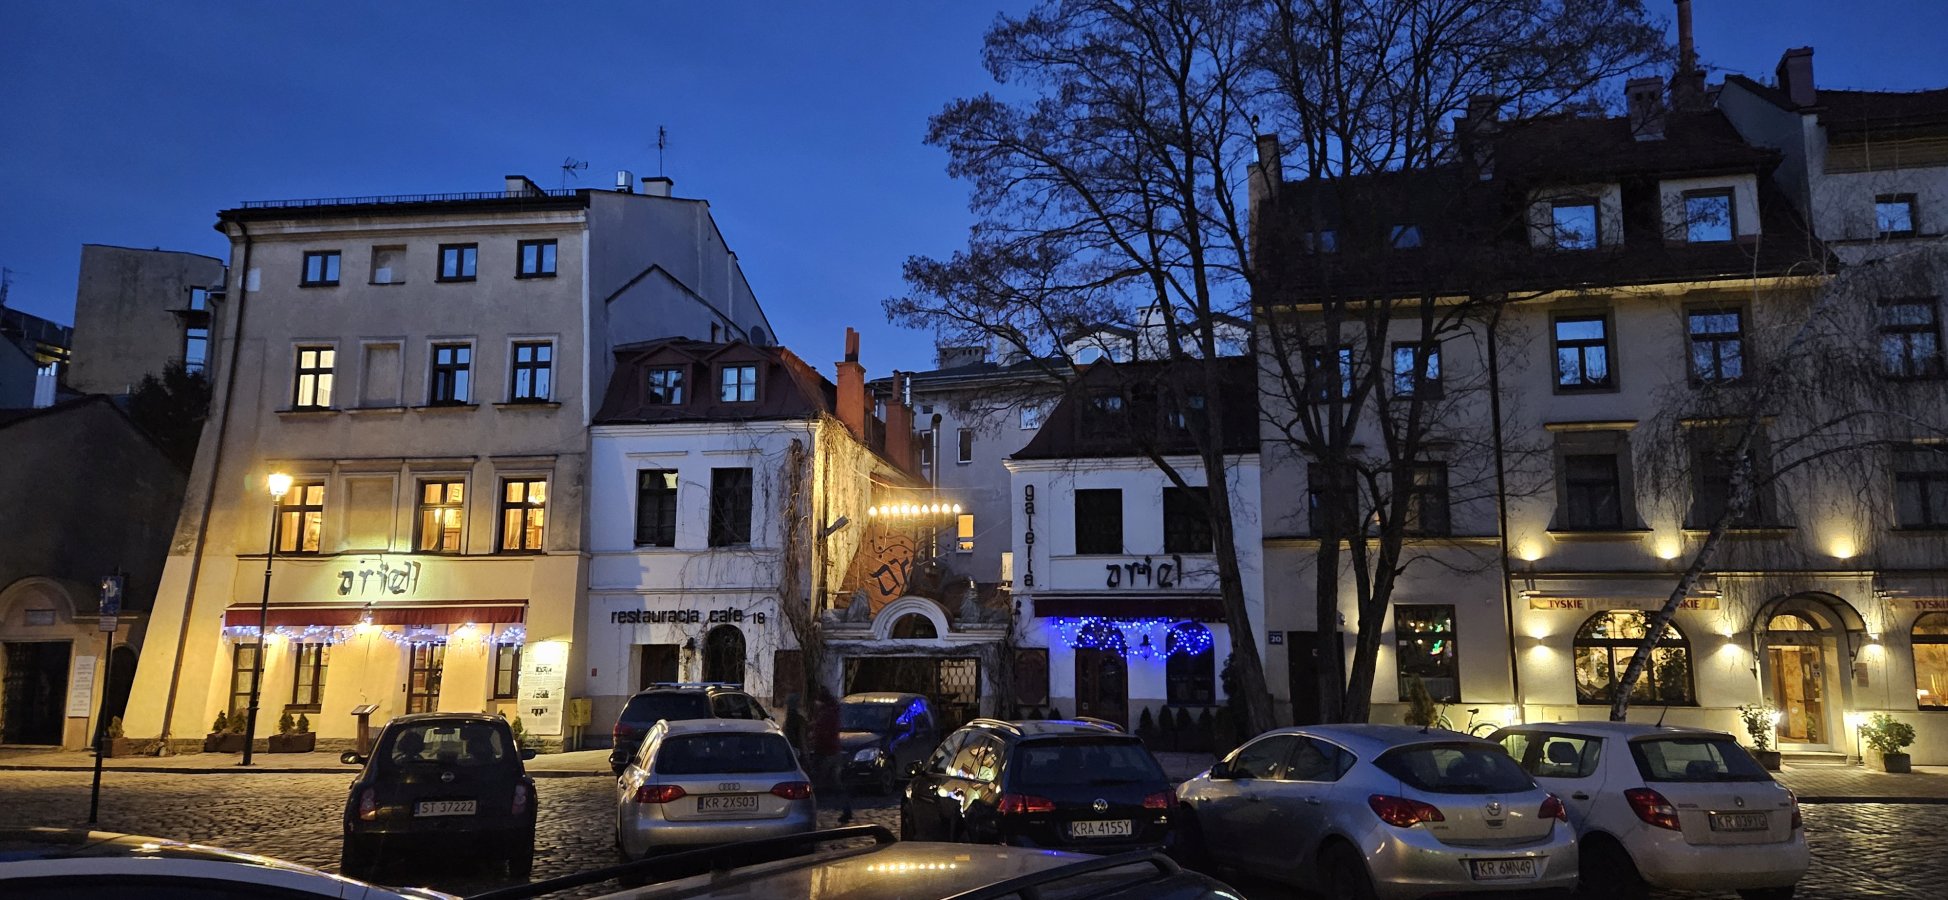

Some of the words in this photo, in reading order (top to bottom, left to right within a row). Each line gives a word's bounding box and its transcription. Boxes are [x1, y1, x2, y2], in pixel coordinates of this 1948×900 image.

[1024, 485, 1035, 586] galeria
[1106, 554, 1182, 587] ariel
[1549, 599, 1583, 609] TYSKIE
[611, 608, 699, 624] restauracja
[709, 607, 743, 623] cafe
[753, 612, 766, 624] 18
[1270, 635, 1281, 643] 20
[422, 802, 436, 813] ST
[440, 801, 474, 812] 37222
[705, 797, 719, 809] KR
[722, 796, 755, 808] 2XS03
[1073, 822, 1094, 835] KRA
[1098, 820, 1130, 834] 4155Y
[1480, 862, 1495, 876] KR
[1500, 861, 1531, 874] 6MN49
